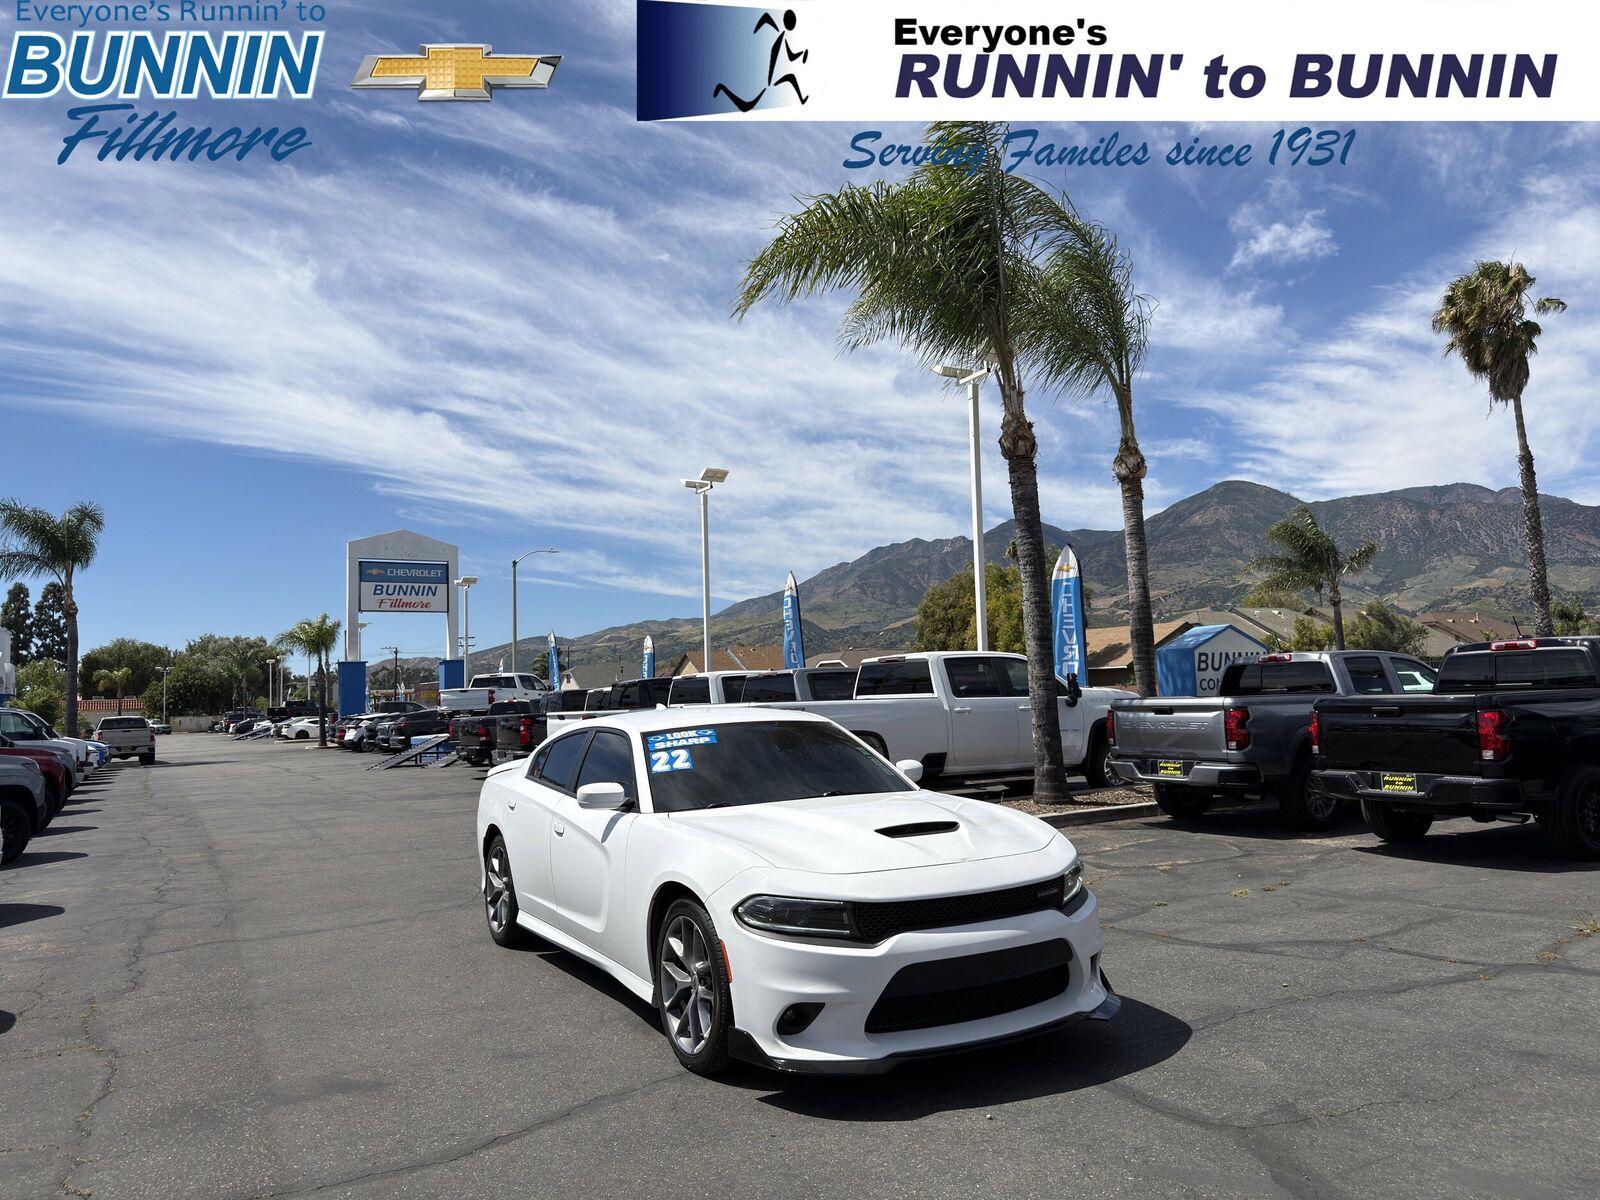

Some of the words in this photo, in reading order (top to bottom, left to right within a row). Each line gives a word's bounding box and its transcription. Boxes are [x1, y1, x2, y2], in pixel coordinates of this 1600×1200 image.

[387, 568, 442, 578] CHEVROLET
[373, 584, 438, 597] BUNNIN
[377, 598, 432, 609] Fillmore
[666, 730, 698, 739] LOOK
[654, 736, 711, 749] SHARP
[651, 748, 692, 773] 22
